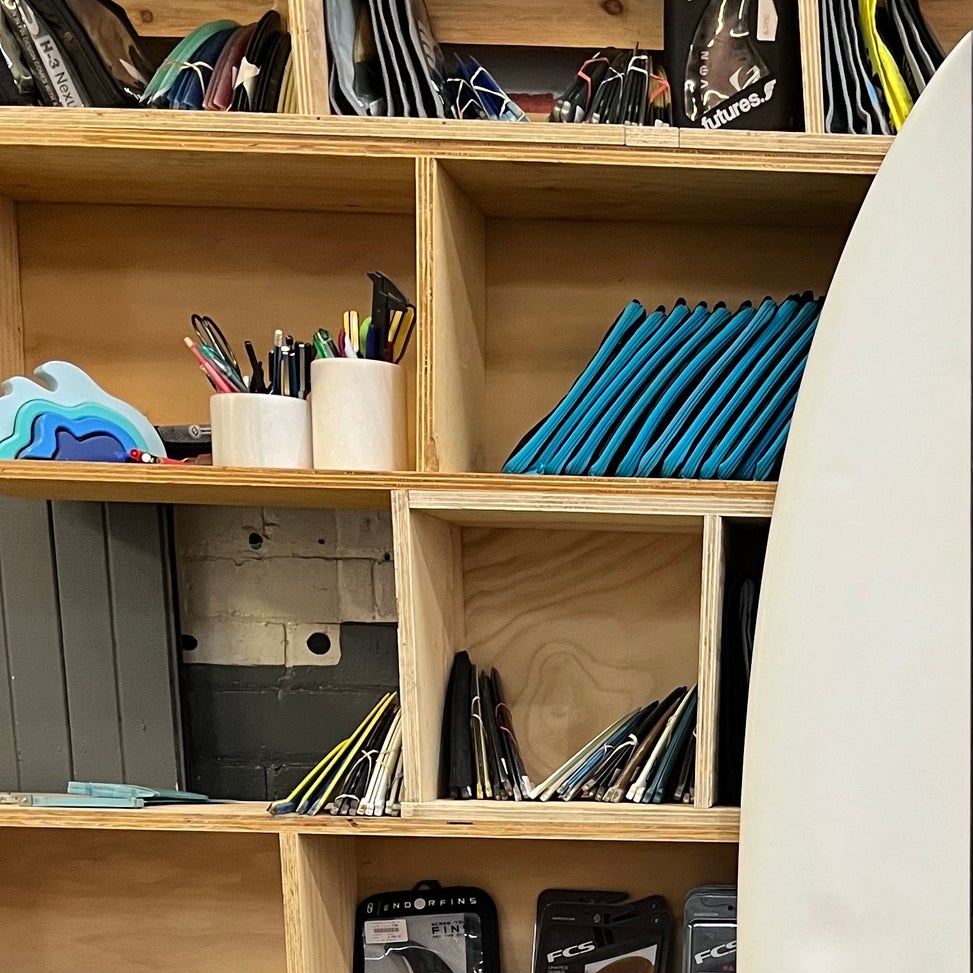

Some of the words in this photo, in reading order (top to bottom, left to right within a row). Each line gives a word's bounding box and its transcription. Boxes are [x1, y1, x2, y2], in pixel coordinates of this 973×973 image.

[54, 71, 77, 107] Nexu
[701, 92, 765, 129] futures.
[546, 940, 596, 963] FCS
